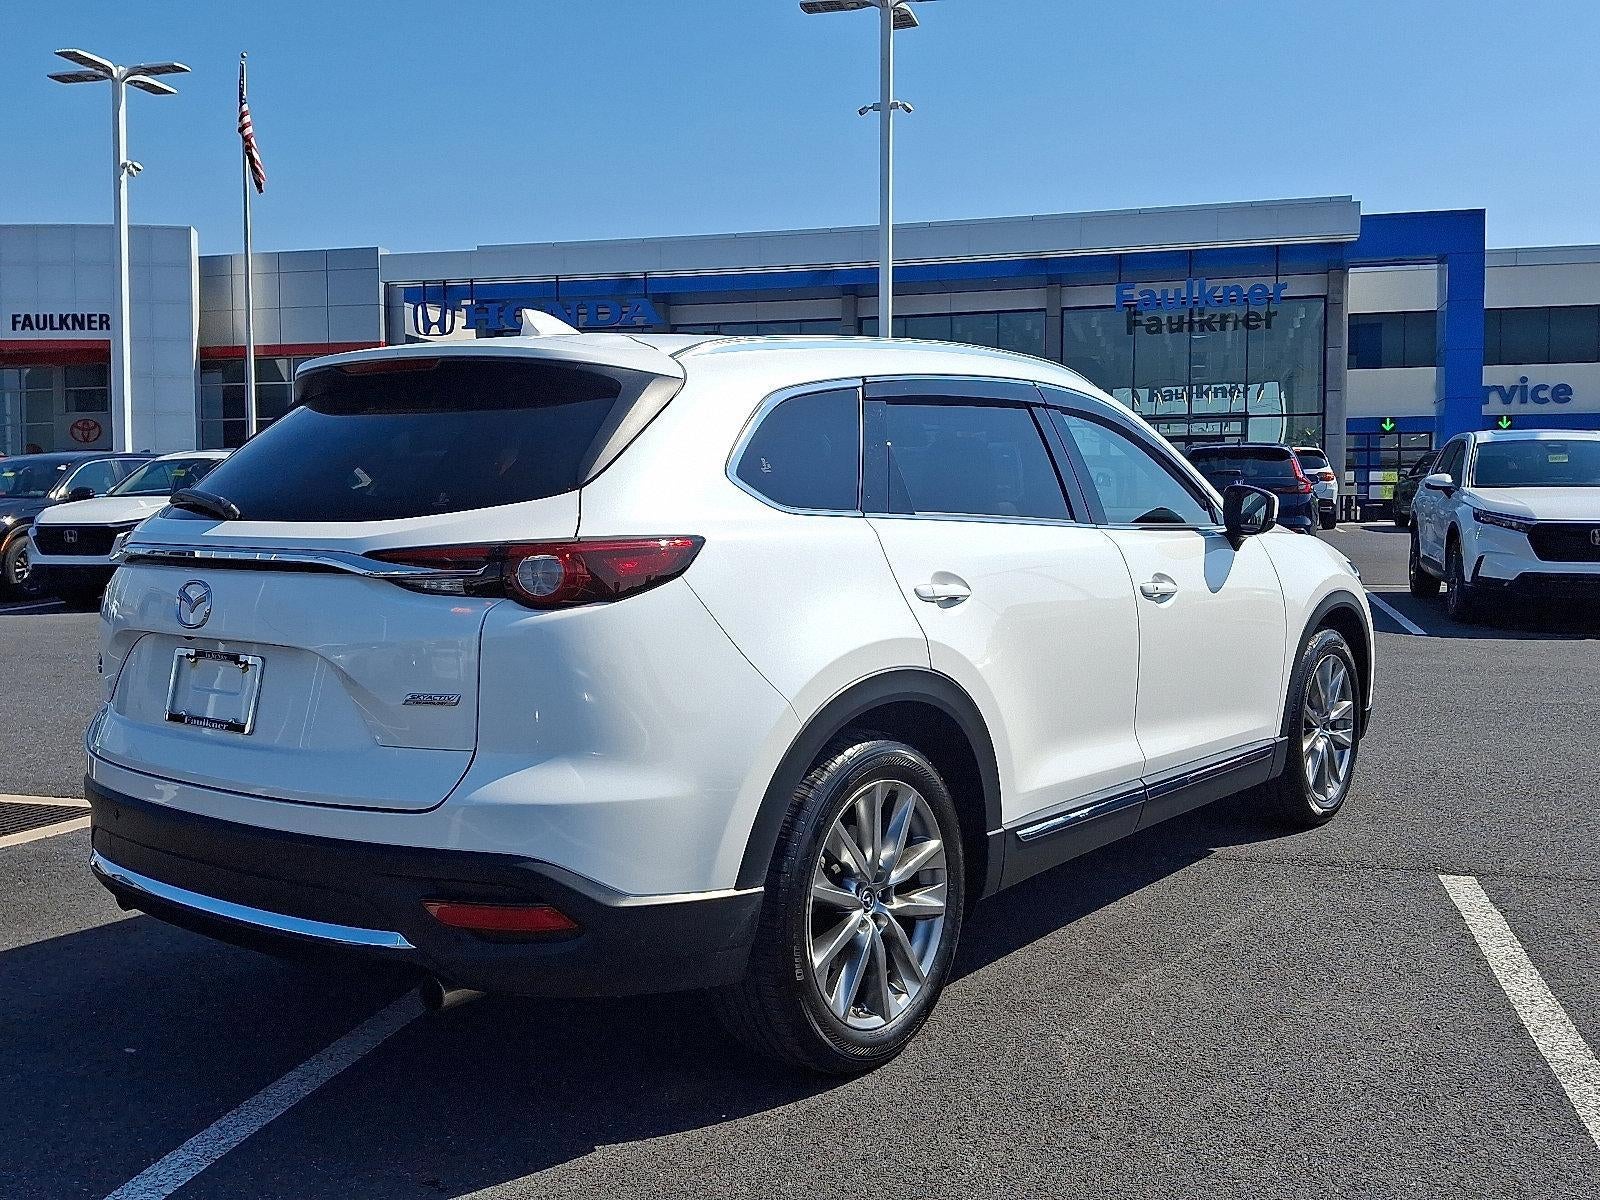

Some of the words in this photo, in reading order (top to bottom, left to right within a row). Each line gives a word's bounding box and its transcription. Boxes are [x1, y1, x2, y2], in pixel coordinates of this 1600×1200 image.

[1115, 278, 1287, 312] Faulkner
[11, 313, 111, 331] FAULKNER
[1482, 375, 1573, 405] rvice
[184, 716, 229, 730] Faulkner
